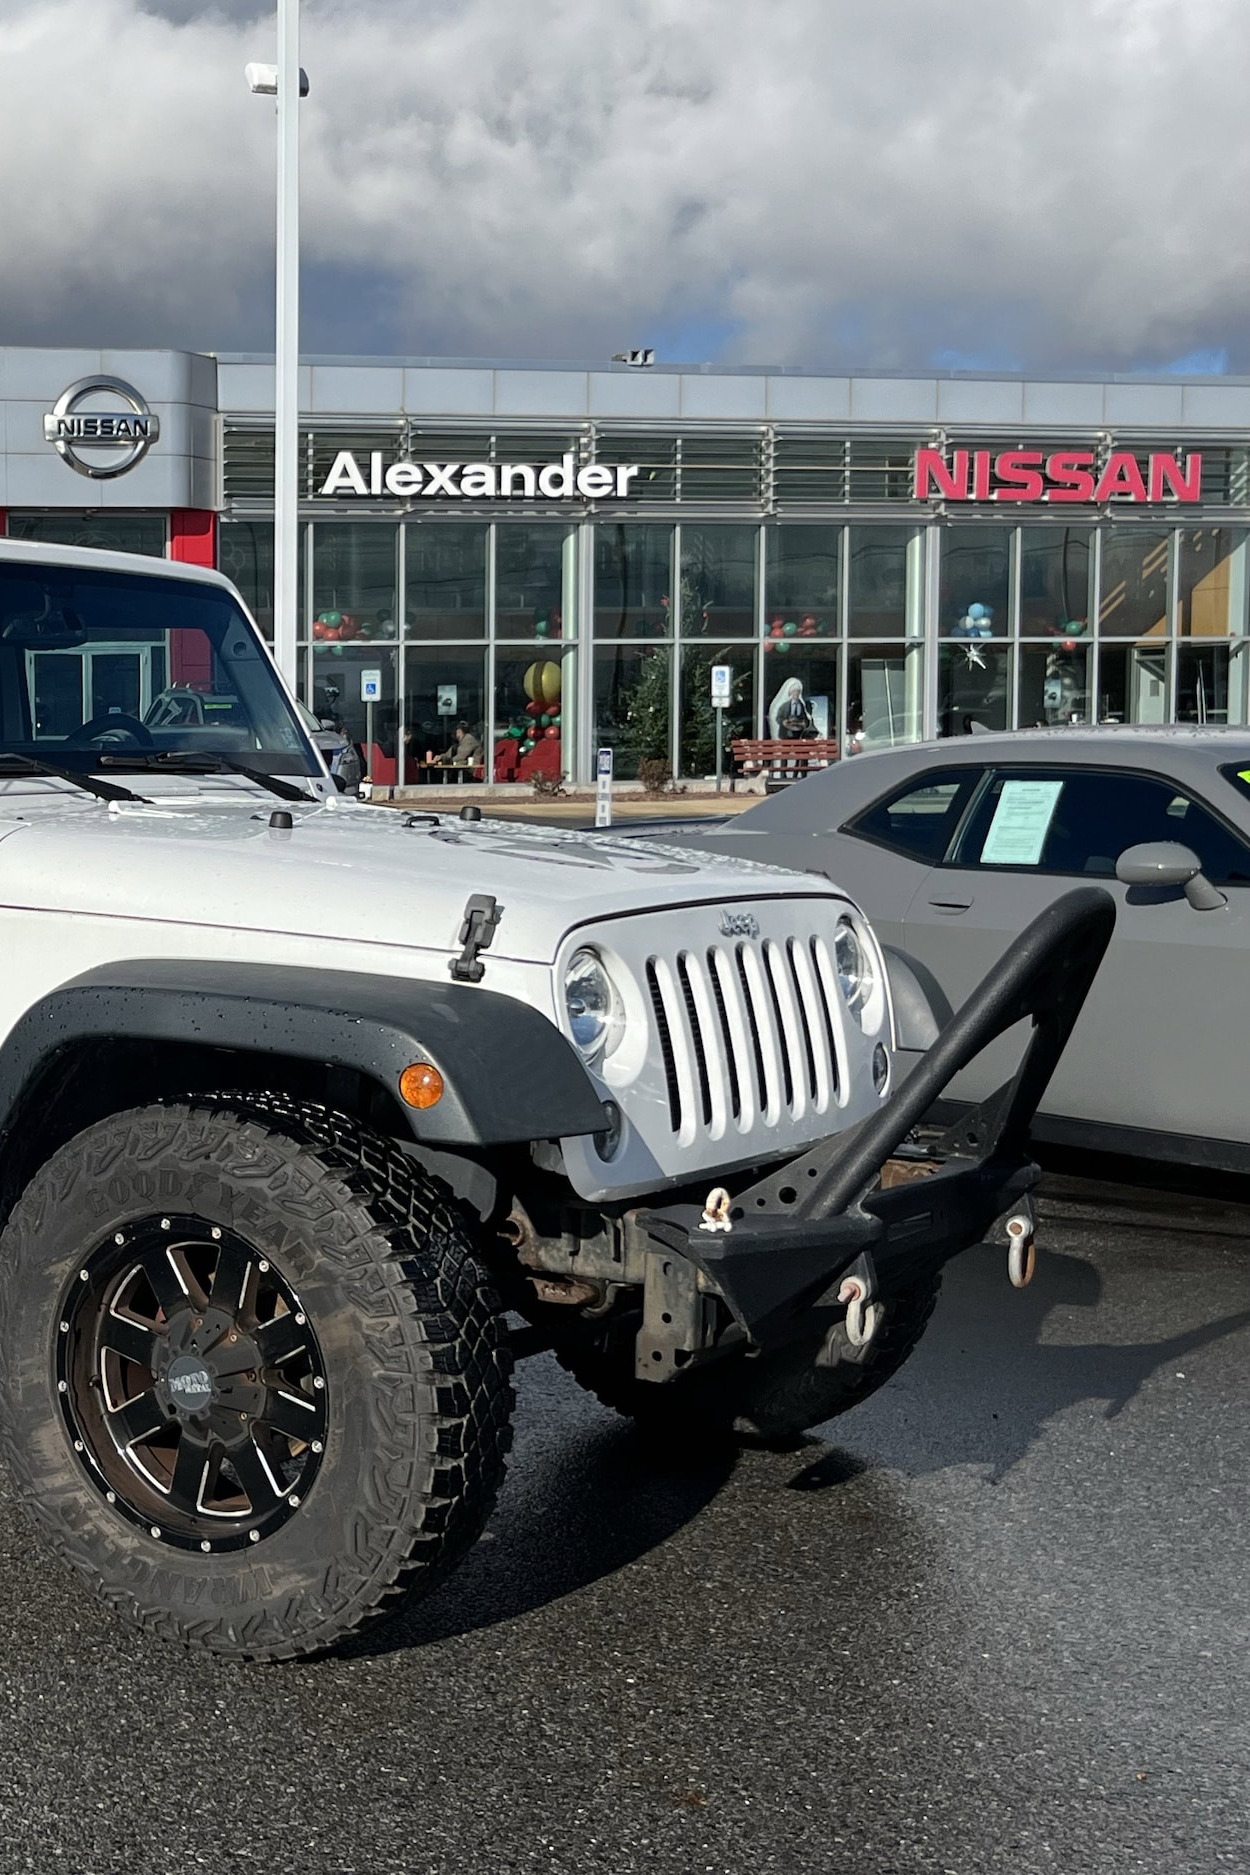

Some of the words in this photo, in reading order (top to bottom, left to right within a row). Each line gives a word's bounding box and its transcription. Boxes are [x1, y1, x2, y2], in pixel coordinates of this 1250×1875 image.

[57, 418, 149, 437] NISSAN
[320, 451, 639, 498] Alexander
[913, 448, 1203, 502] NISSAN
